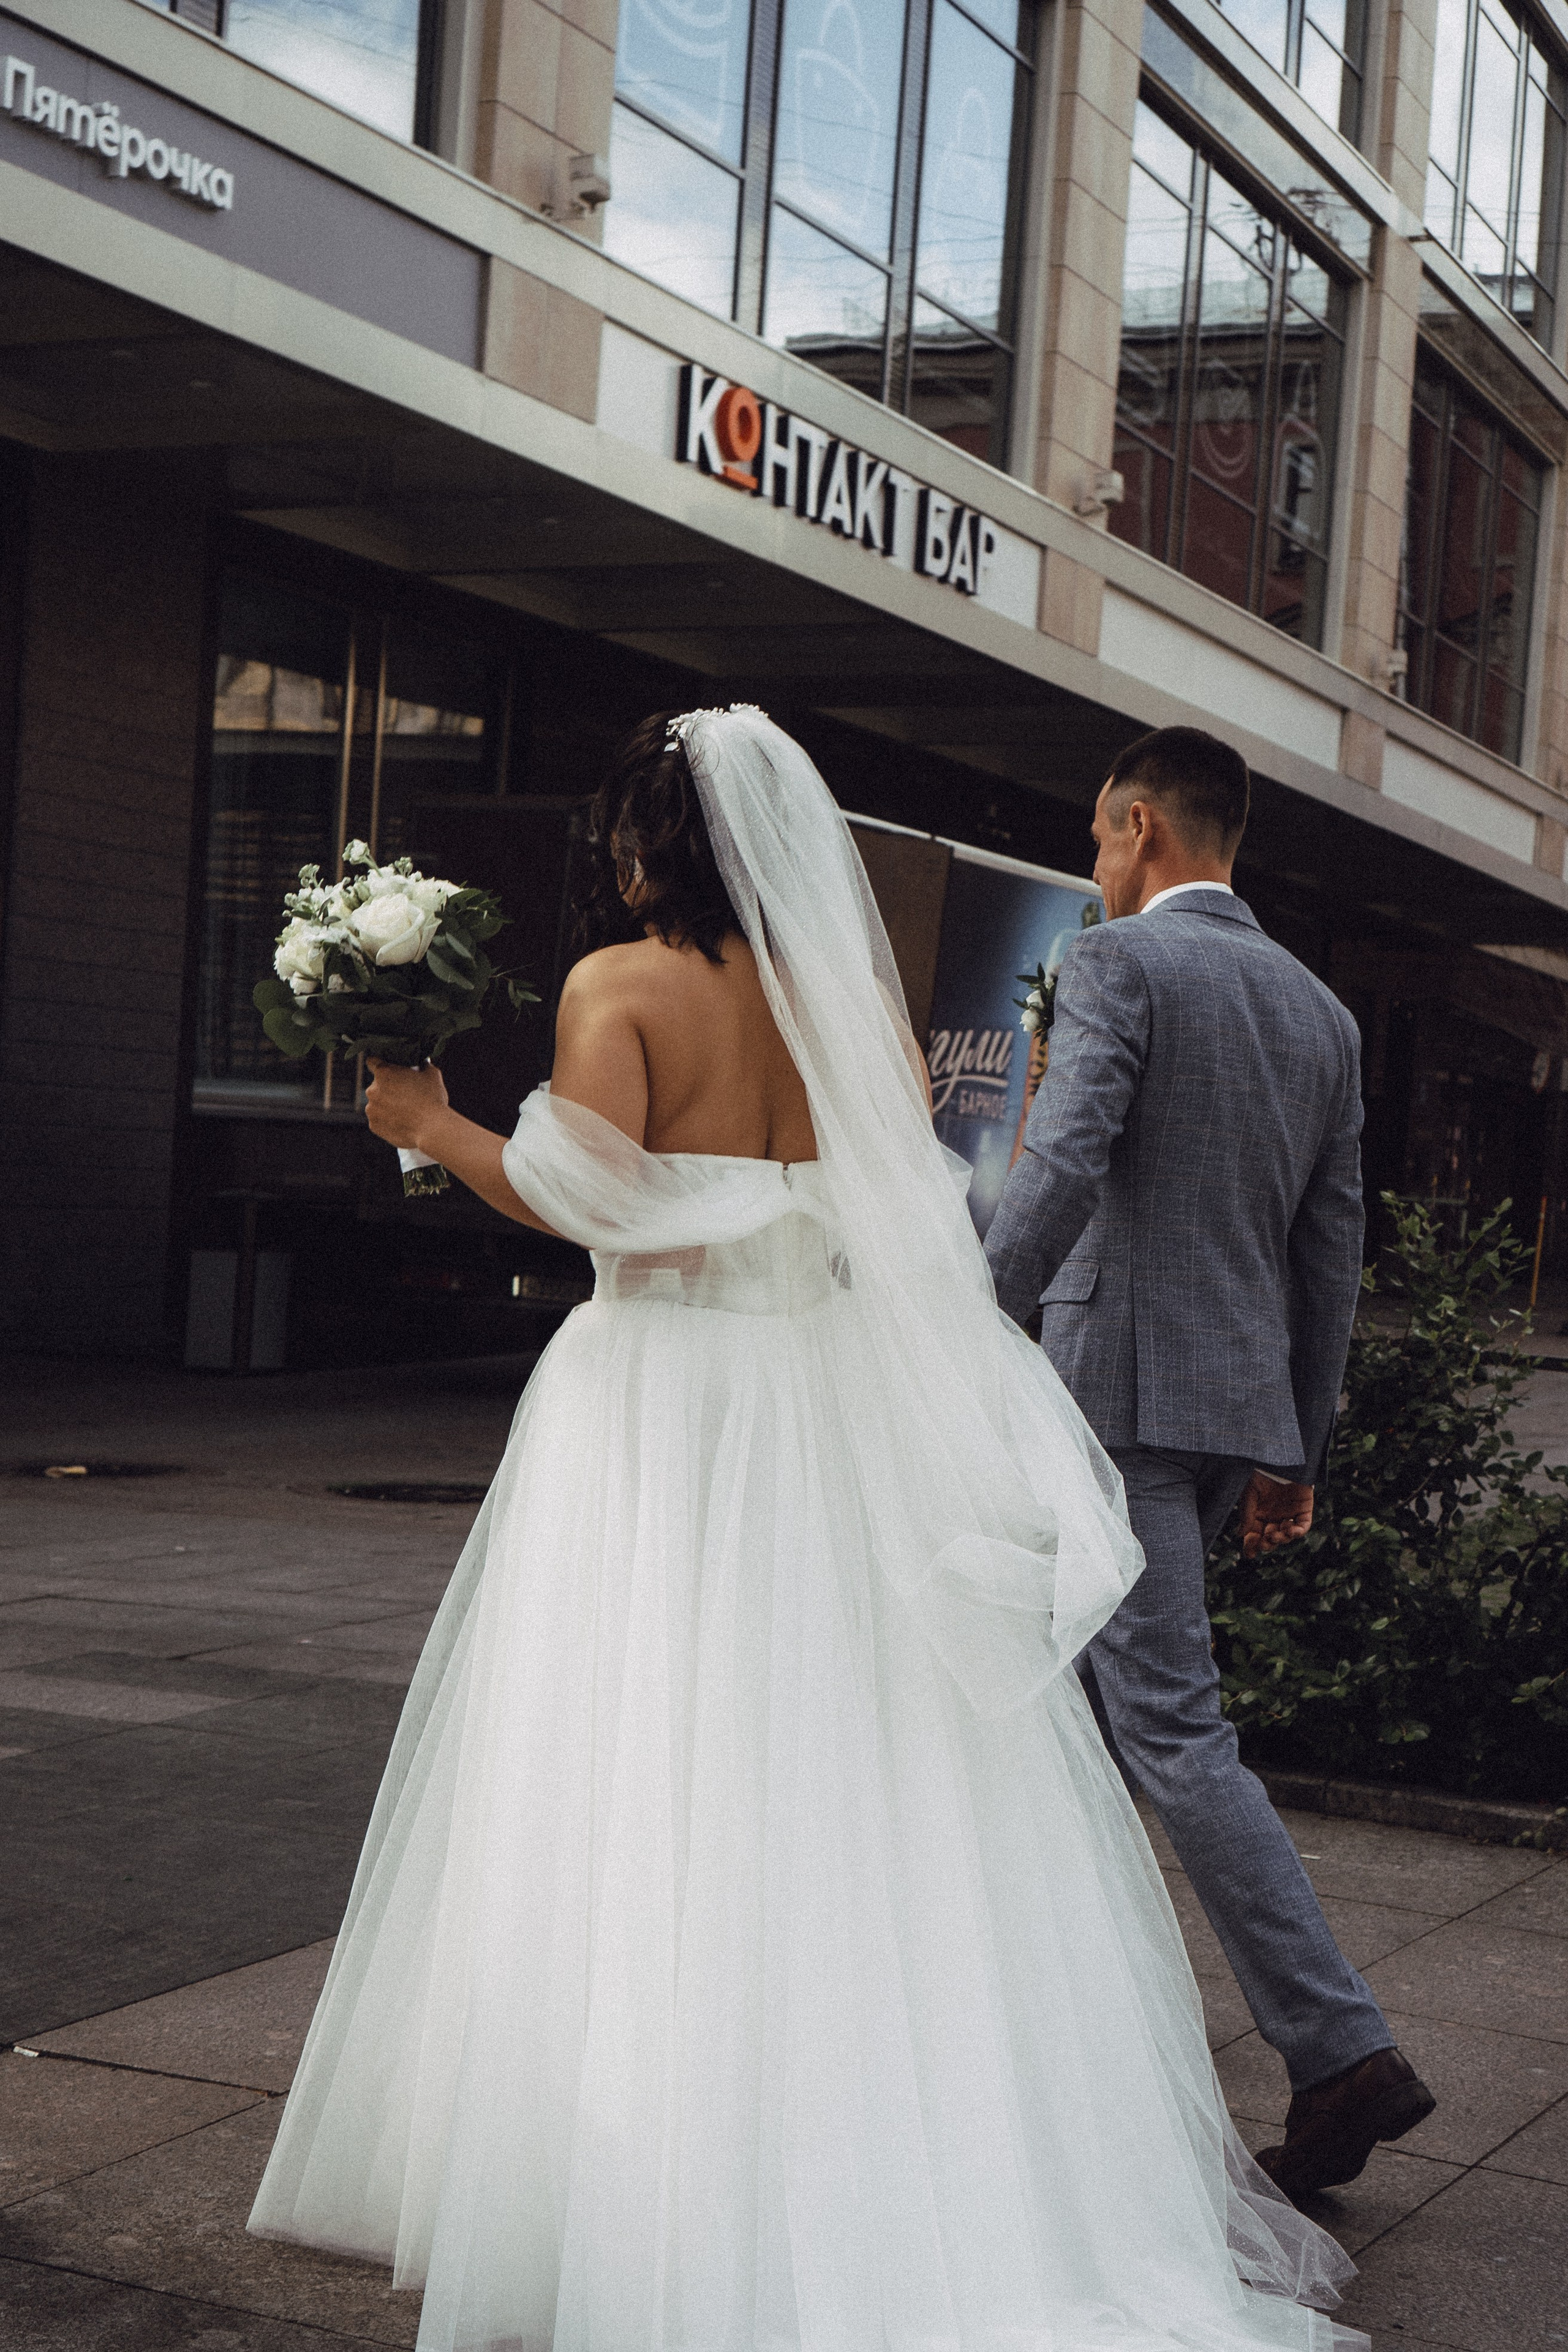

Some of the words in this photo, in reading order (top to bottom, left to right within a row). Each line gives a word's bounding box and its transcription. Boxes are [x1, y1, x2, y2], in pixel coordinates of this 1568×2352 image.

[3, 55, 234, 210] Пятёрочка
[677, 364, 917, 556] КОНТАКТ
[916, 488, 1001, 595] БАР
